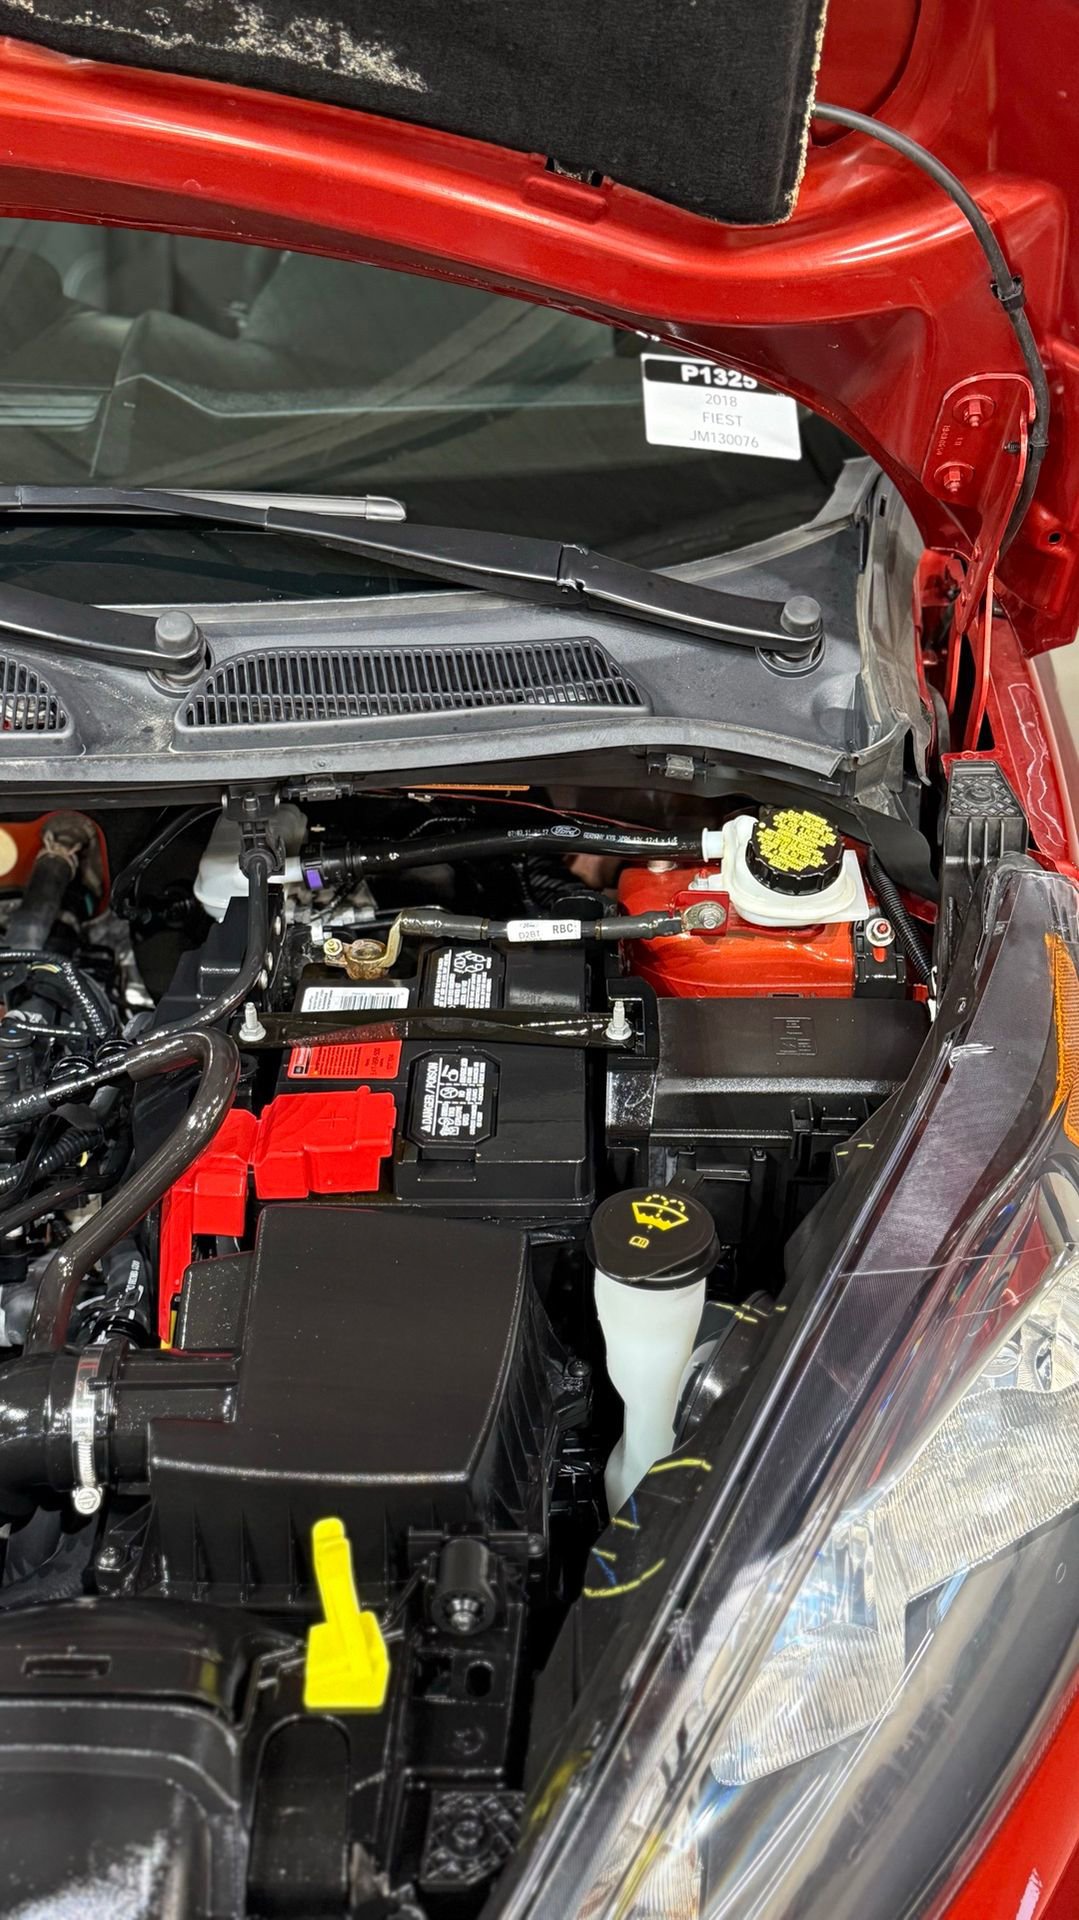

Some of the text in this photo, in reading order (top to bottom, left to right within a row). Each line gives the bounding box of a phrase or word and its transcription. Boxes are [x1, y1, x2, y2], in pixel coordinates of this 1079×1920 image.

[681, 364, 758, 390] P1325
[705, 393, 738, 407] 2018
[702, 411, 743, 427] FIEST
[689, 430, 760, 448] JM130076
[552, 826, 578, 837] Ford
[552, 923, 574, 935] RBC
